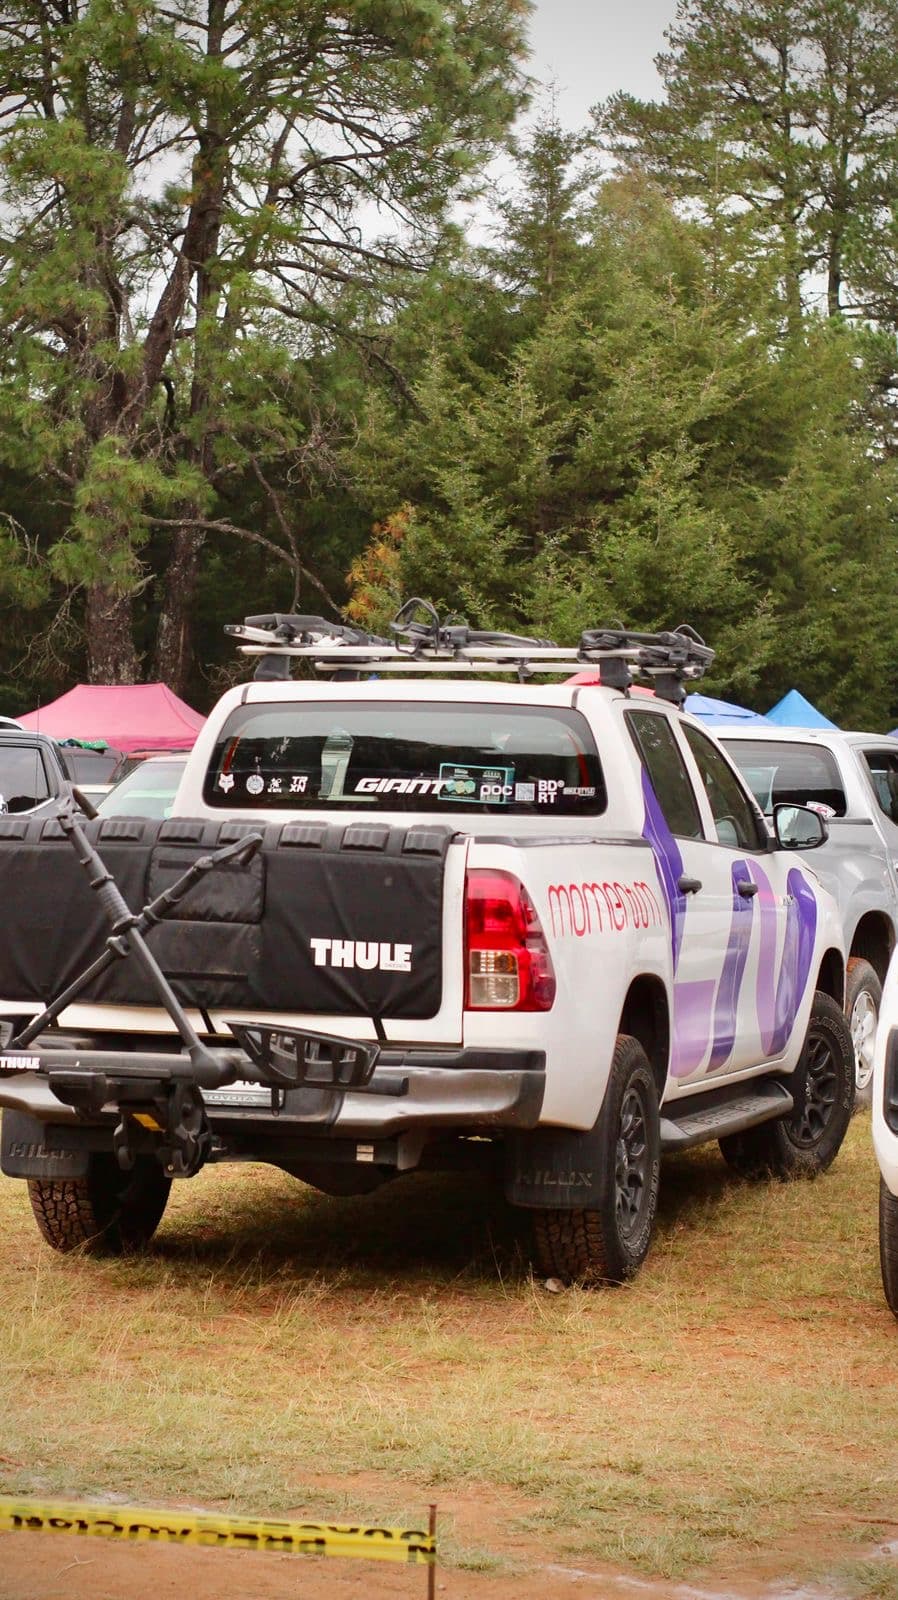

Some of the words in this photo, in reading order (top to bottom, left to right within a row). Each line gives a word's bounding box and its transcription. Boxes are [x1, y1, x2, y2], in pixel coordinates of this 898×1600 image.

[354, 778, 451, 794] GIANT
[538, 791, 557, 803] RT
[548, 881, 663, 938] momentum
[310, 937, 412, 972] THULE
[0, 1056, 40, 1070] THULE
[206, 1094, 255, 1102] TOYOTA
